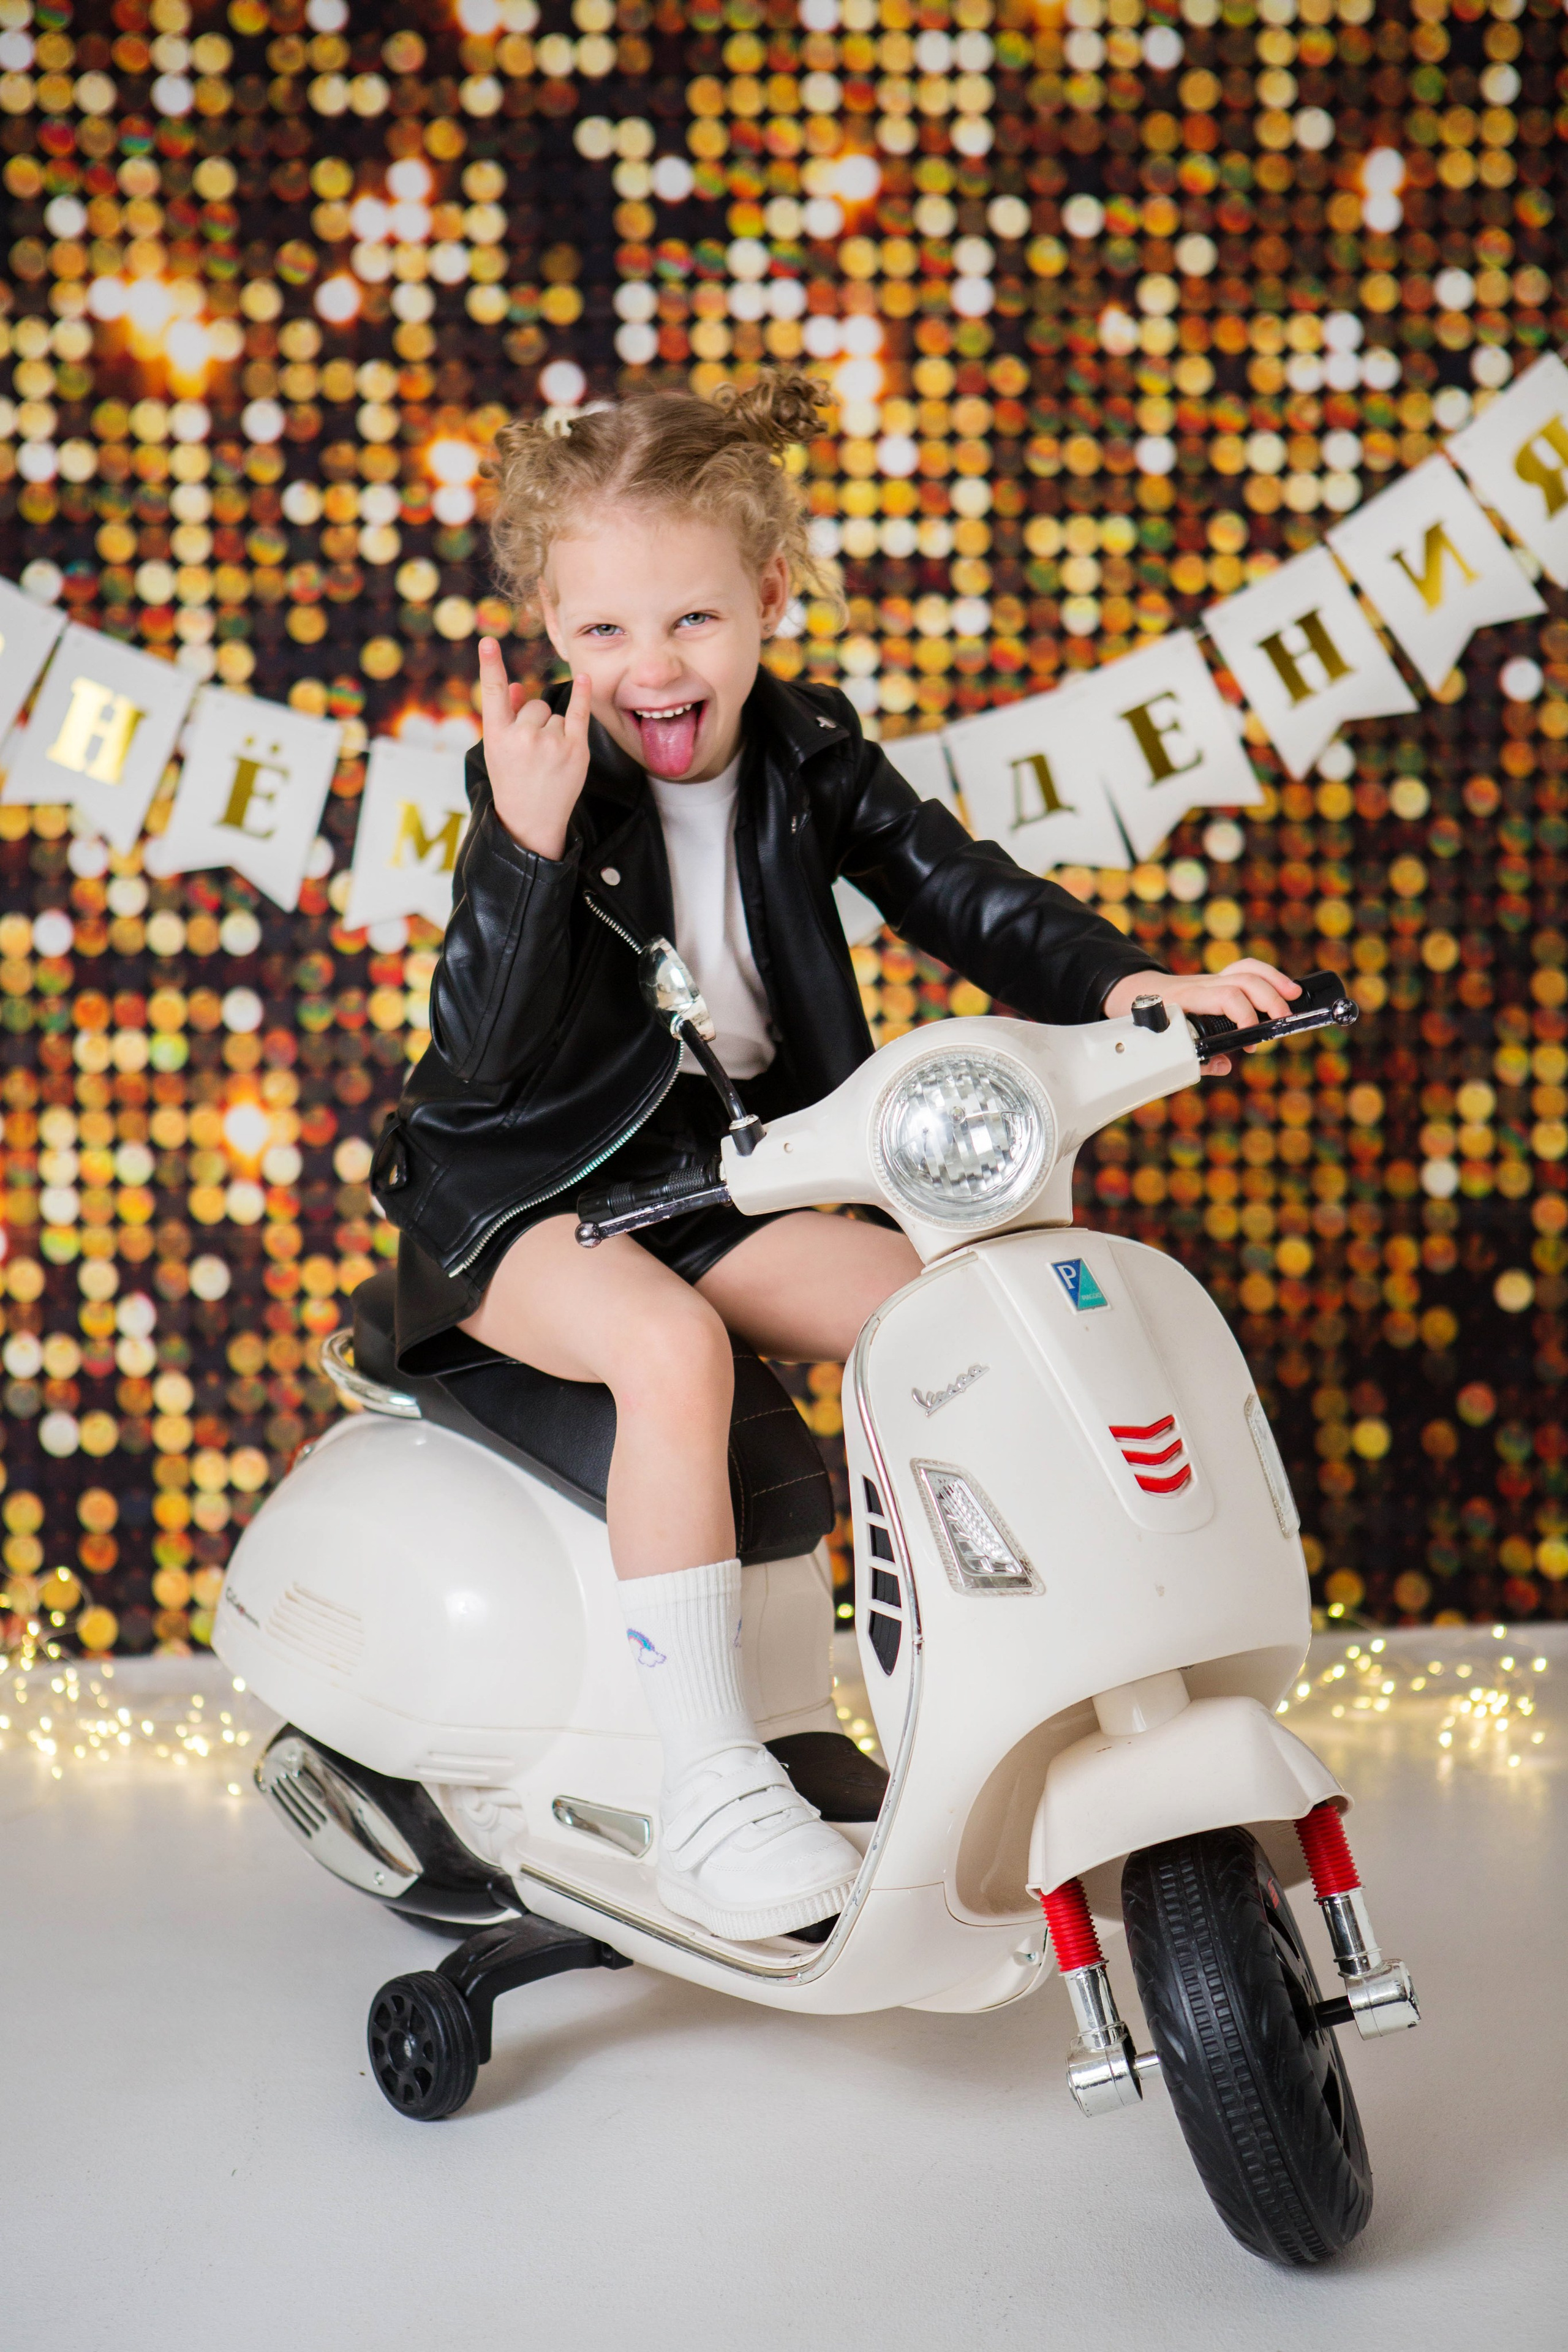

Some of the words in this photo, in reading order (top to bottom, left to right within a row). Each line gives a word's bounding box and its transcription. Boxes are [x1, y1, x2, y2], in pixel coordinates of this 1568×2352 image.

[0, 631, 465, 872] НЁМ
[1009, 415, 1568, 831] ДЕНИЯ
[1057, 1265, 1076, 1289] P
